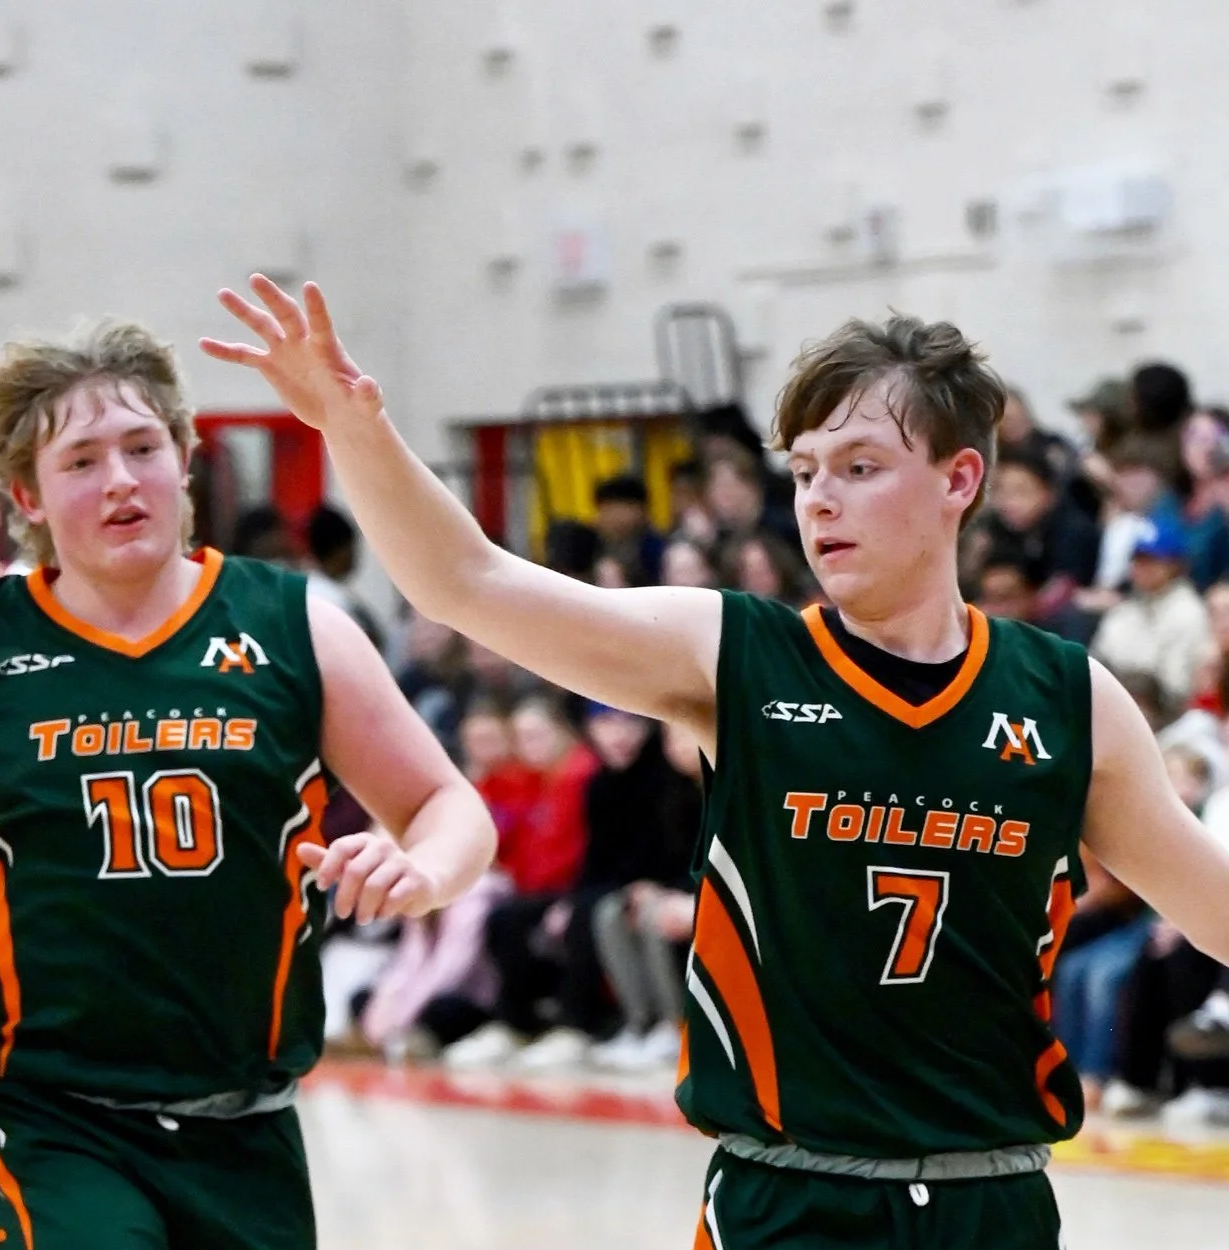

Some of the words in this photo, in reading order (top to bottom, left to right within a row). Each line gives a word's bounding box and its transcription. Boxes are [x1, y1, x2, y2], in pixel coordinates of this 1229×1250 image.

[28, 717, 258, 762] TOILERS
[77, 706, 228, 723] PEACOCK
[80, 768, 225, 880] 10
[782, 791, 1031, 858] TOILERS
[837, 790, 1004, 816] PEACOCK
[866, 865, 951, 986] 7
